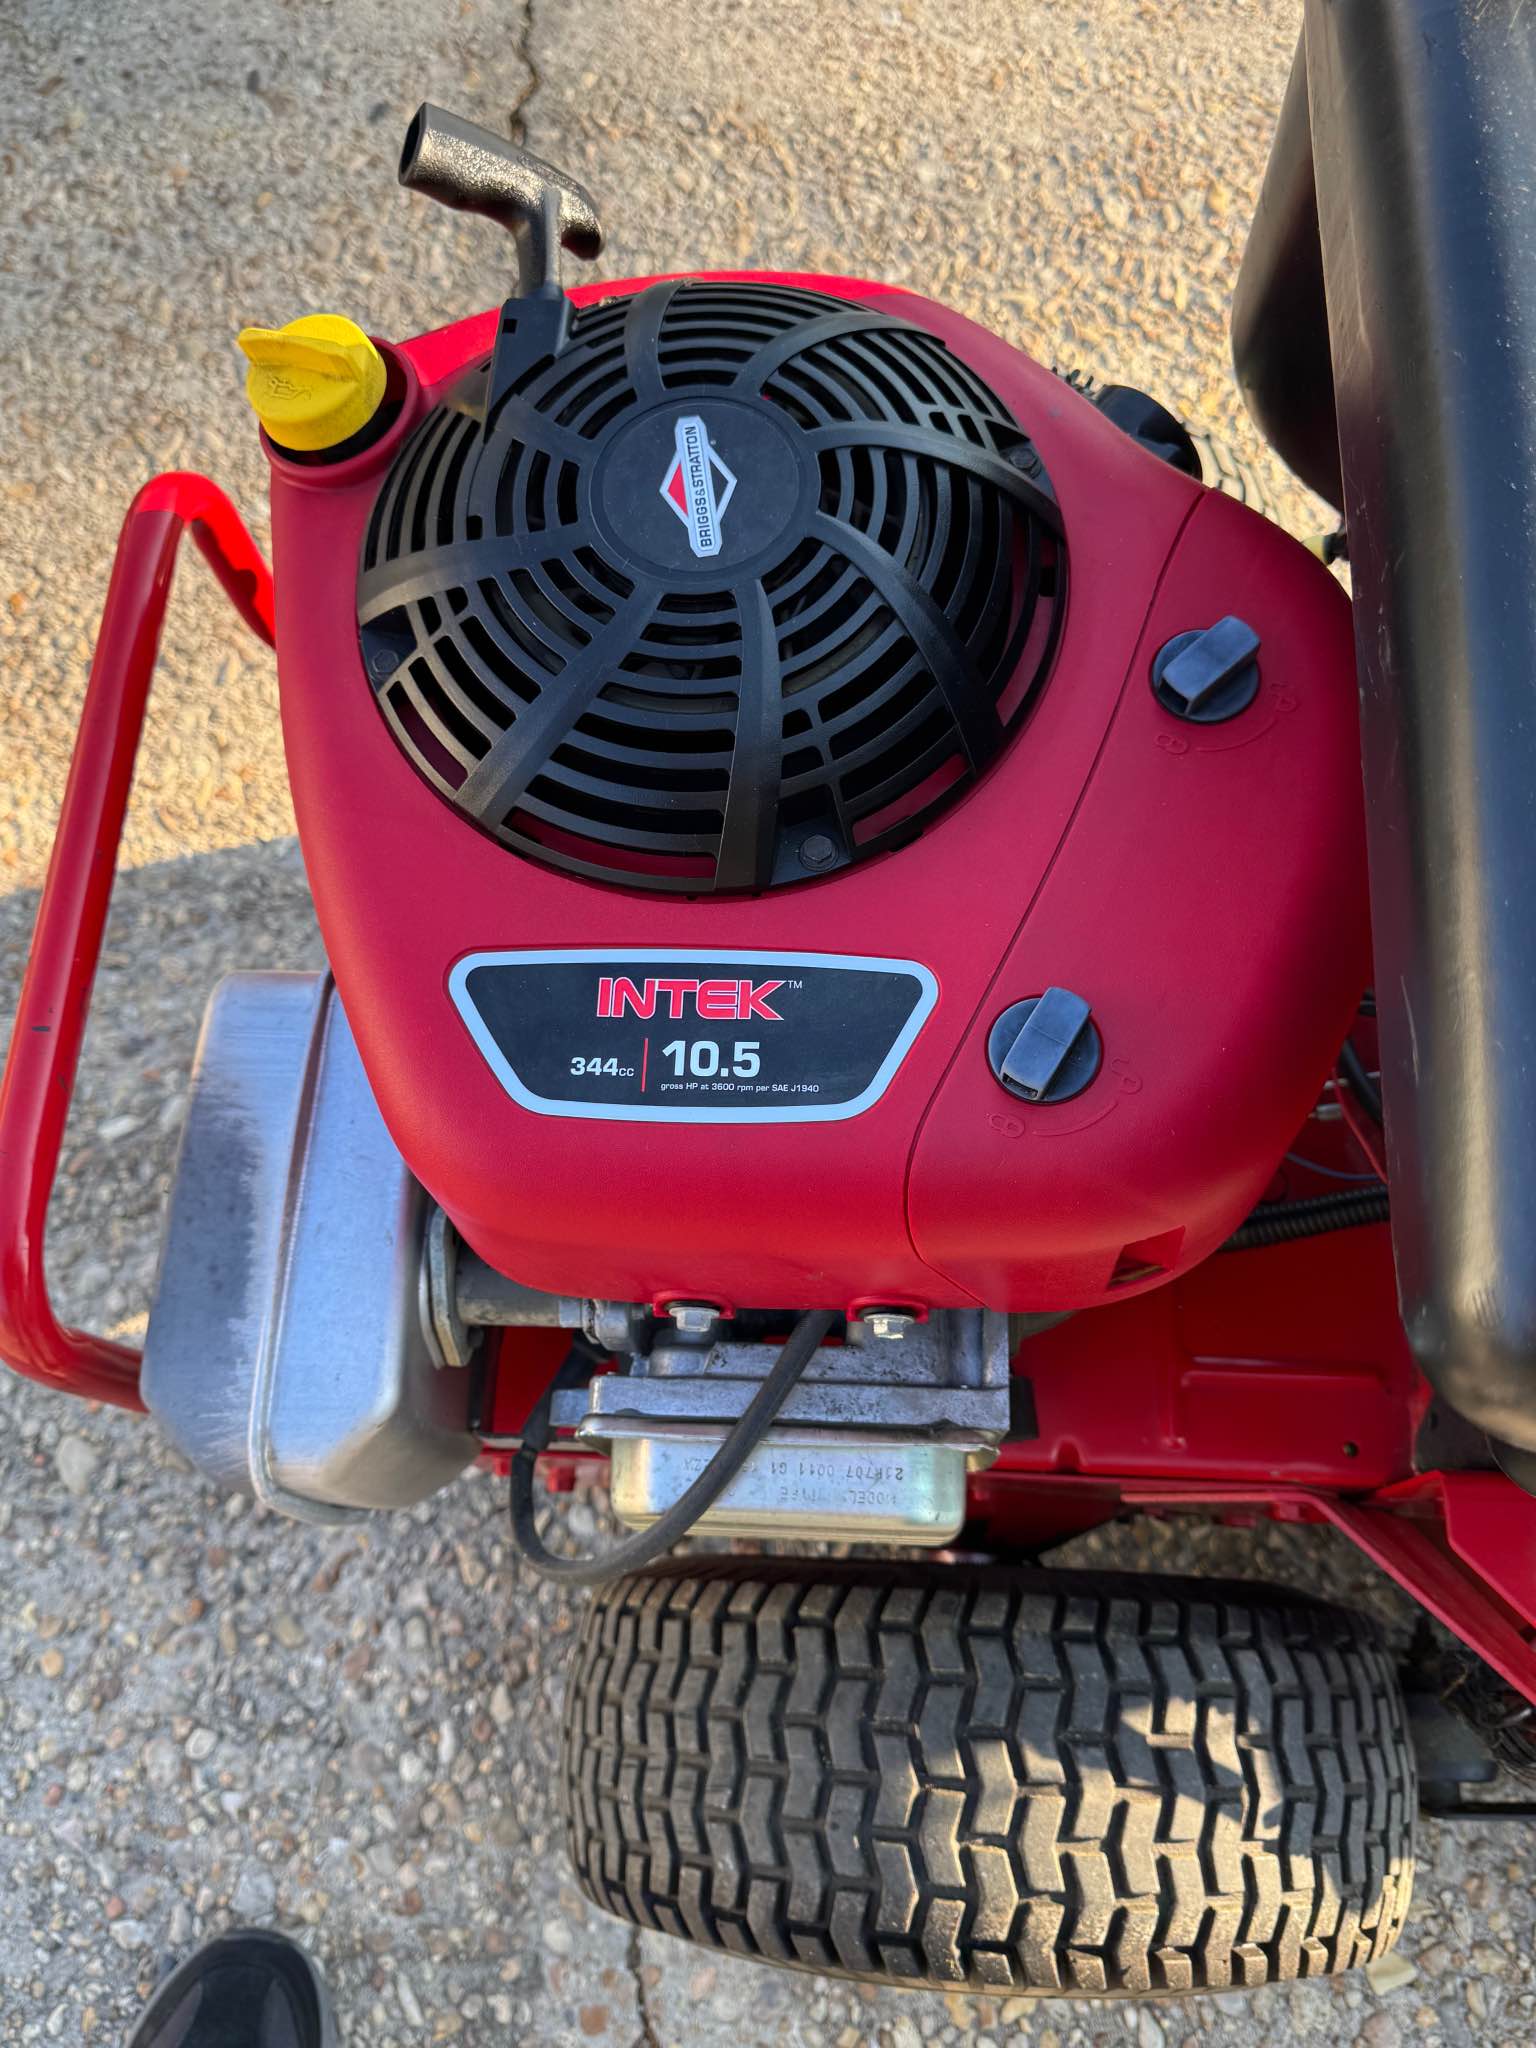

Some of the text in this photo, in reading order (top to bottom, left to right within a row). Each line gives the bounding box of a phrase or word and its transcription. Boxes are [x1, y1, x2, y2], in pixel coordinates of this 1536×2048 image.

[597, 977, 787, 1021] INTEK
[662, 1040, 761, 1078] 10.5
[660, 1083, 683, 1091] gross
[700, 1083, 709, 1091] at
[711, 1083, 735, 1091] 3600
[736, 1085, 754, 1093] rpm
[755, 1085, 770, 1093] per
[771, 1084, 788, 1092] SAE
[790, 1085, 820, 1093] J1940
